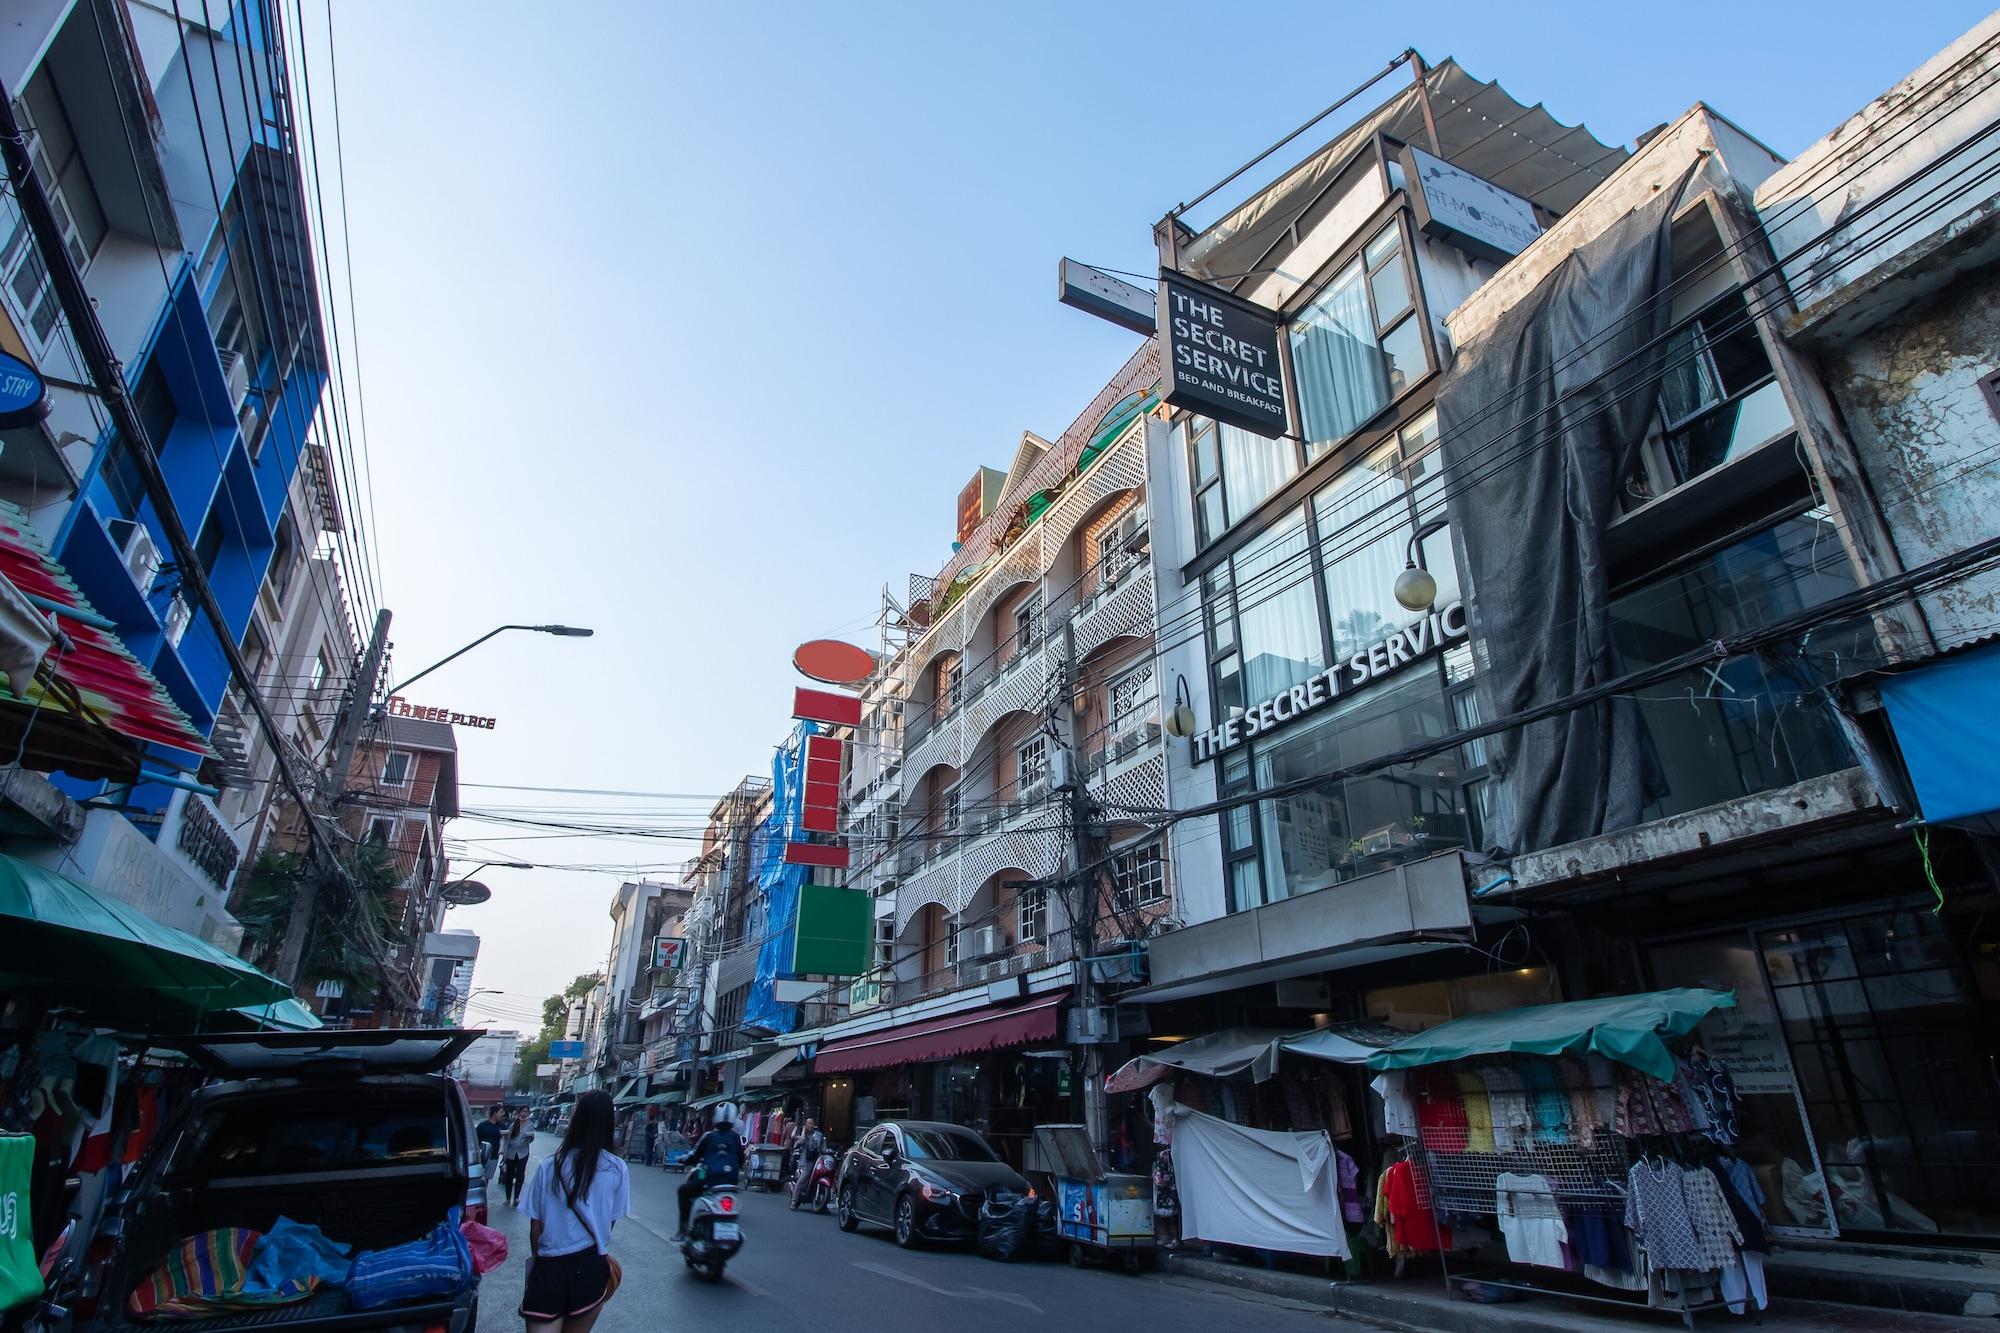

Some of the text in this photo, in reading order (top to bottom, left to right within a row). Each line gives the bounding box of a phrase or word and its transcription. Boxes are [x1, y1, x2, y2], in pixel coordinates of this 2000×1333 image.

[1171, 290, 1224, 329] THE
[1174, 317, 1268, 368] SECRET
[2, 375, 33, 398] STAY
[1176, 344, 1281, 400] SERVICE
[1178, 371, 1283, 415] BED AND BREAKFAST
[1193, 602, 1468, 762] THE SECRET SERVIC
[451, 712, 496, 730] PLACE
